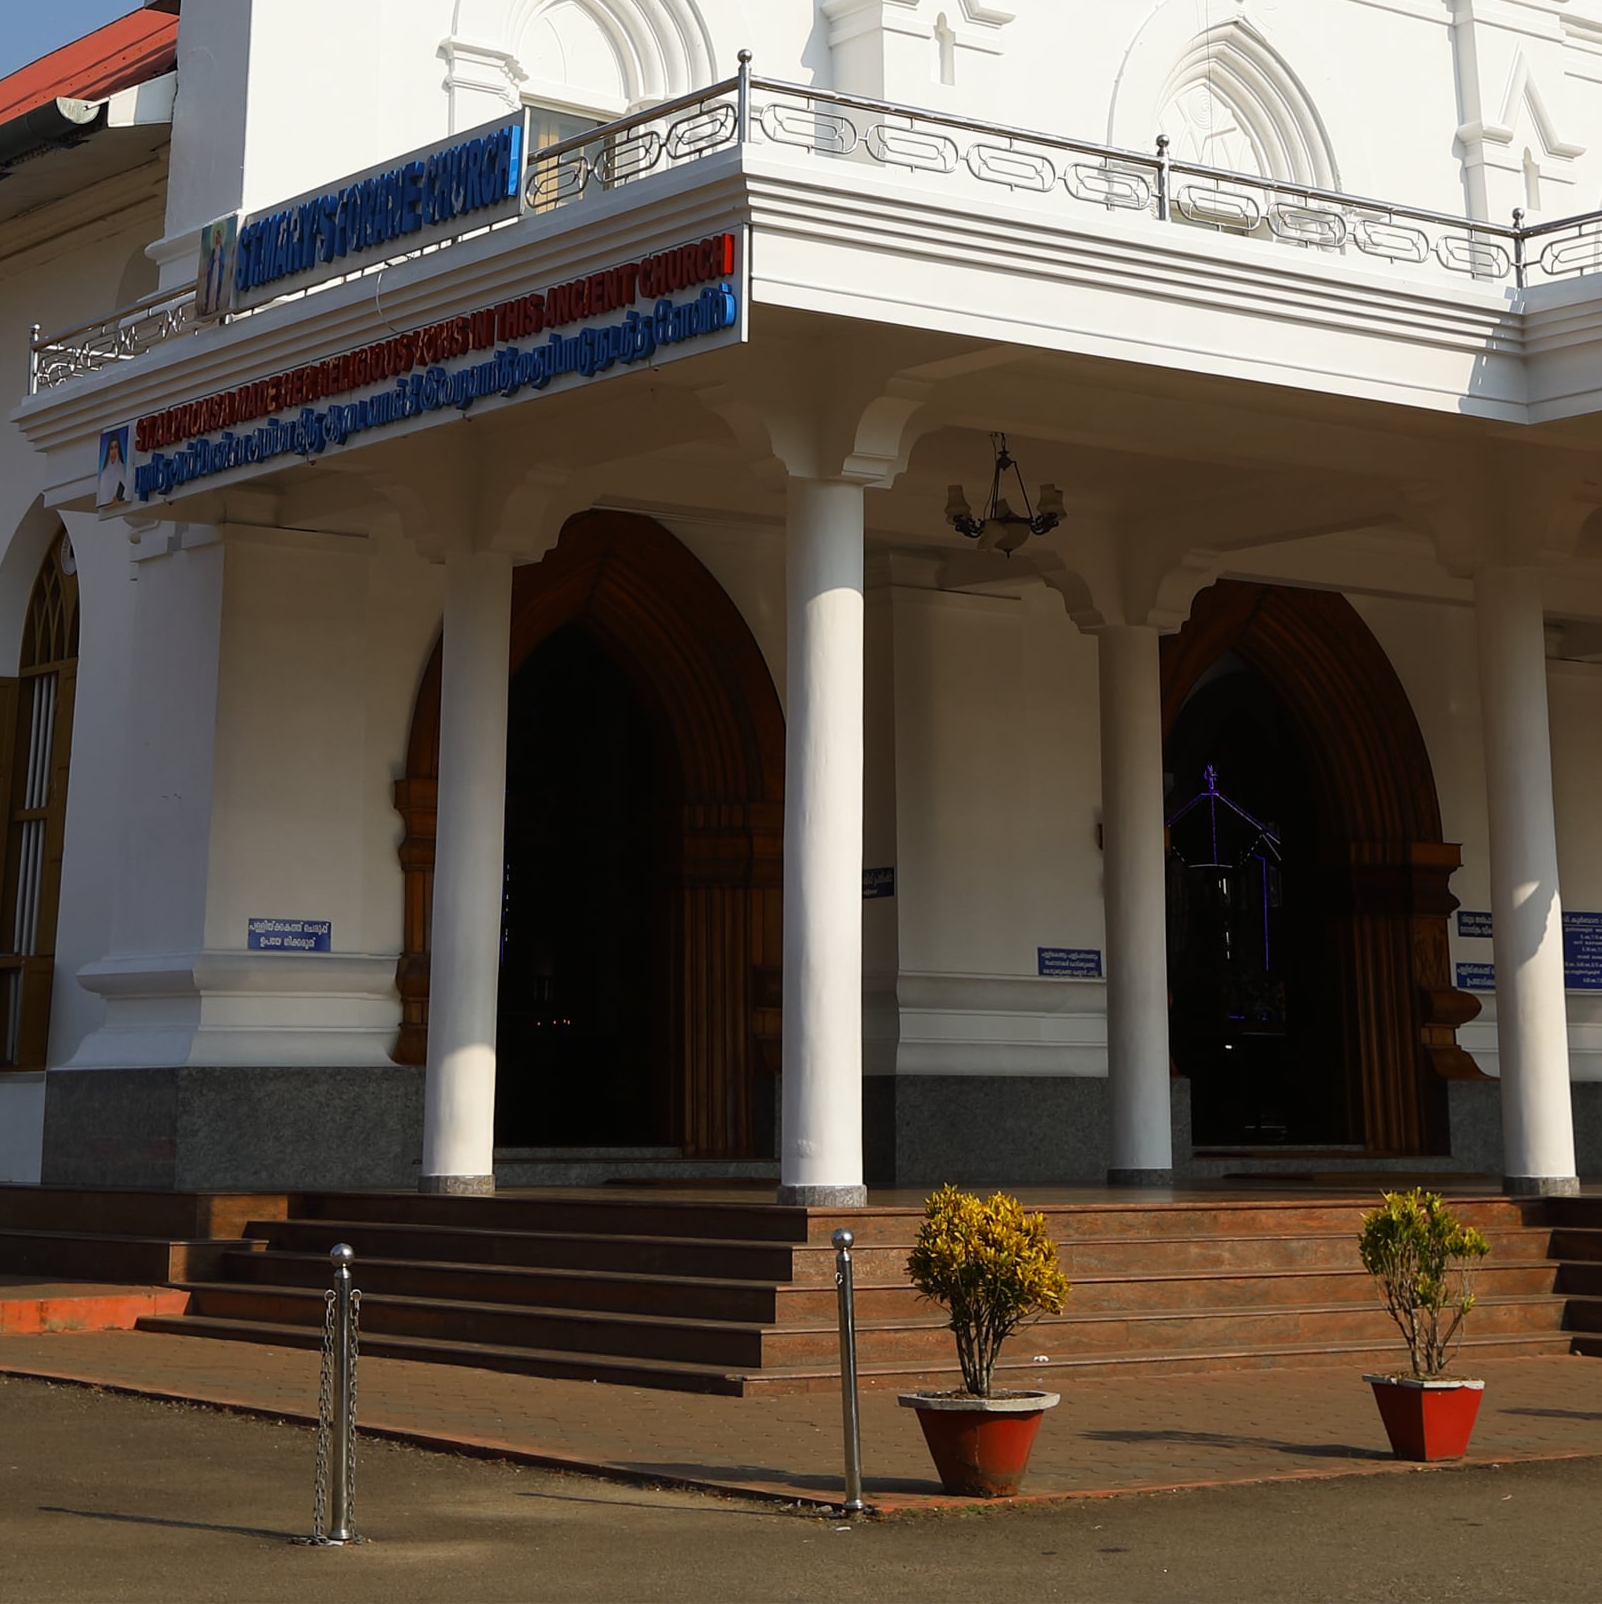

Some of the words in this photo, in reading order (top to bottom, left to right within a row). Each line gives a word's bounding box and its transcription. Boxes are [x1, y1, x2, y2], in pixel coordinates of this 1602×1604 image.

[334, 161, 425, 257] FORANE
[422, 125, 523, 226] CHURCH
[236, 375, 285, 422] MADE
[283, 365, 321, 408] HER
[317, 334, 415, 401] RELIGIOUS
[468, 308, 496, 350] IN
[494, 294, 545, 342] THIS
[542, 262, 640, 328] ANCIENT
[638, 233, 735, 299] CHURCH
